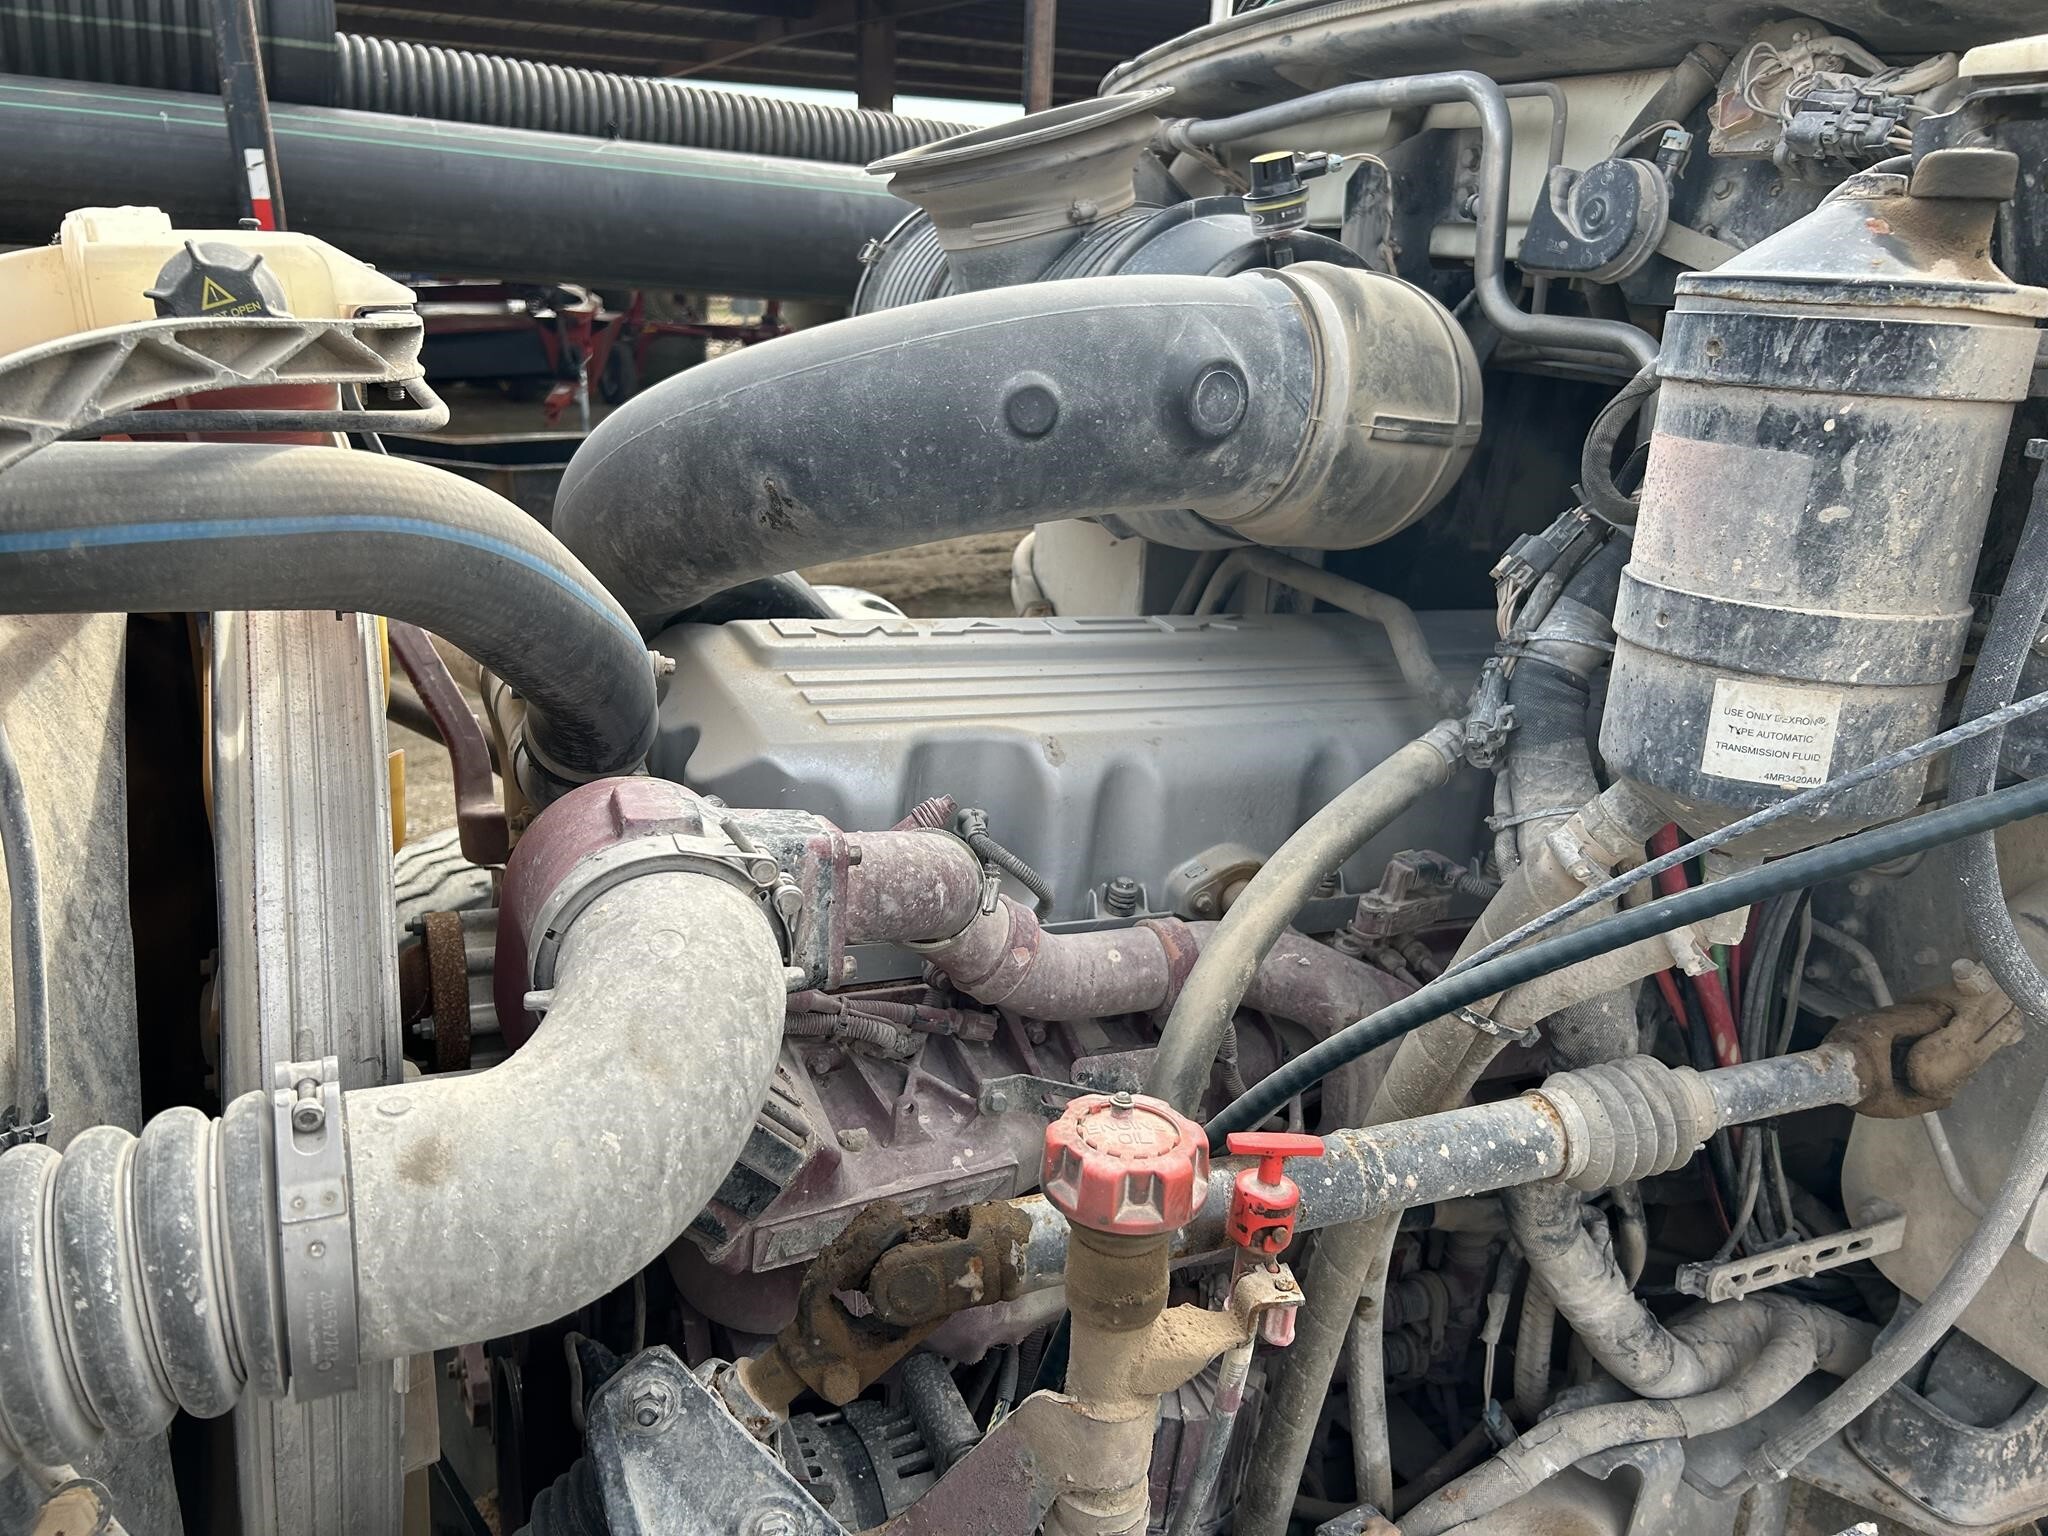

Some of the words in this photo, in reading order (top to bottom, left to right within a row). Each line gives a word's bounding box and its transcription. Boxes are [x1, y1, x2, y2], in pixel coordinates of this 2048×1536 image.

[231, 301, 261, 317] OPEN
[770, 614, 1272, 638] MACK
[1724, 707, 1743, 718] USE
[1746, 711, 1772, 722] ONLY
[1728, 725, 1754, 736] TYPE
[1756, 730, 1814, 744] AUTOMATIC
[1715, 741, 1790, 759] TRANSMISSION
[1792, 752, 1821, 762] FLUID
[1764, 772, 1822, 785] 4MR3420AM
[1087, 1119, 1166, 1135] ENGINE
[1118, 1133, 1153, 1144] OIL
